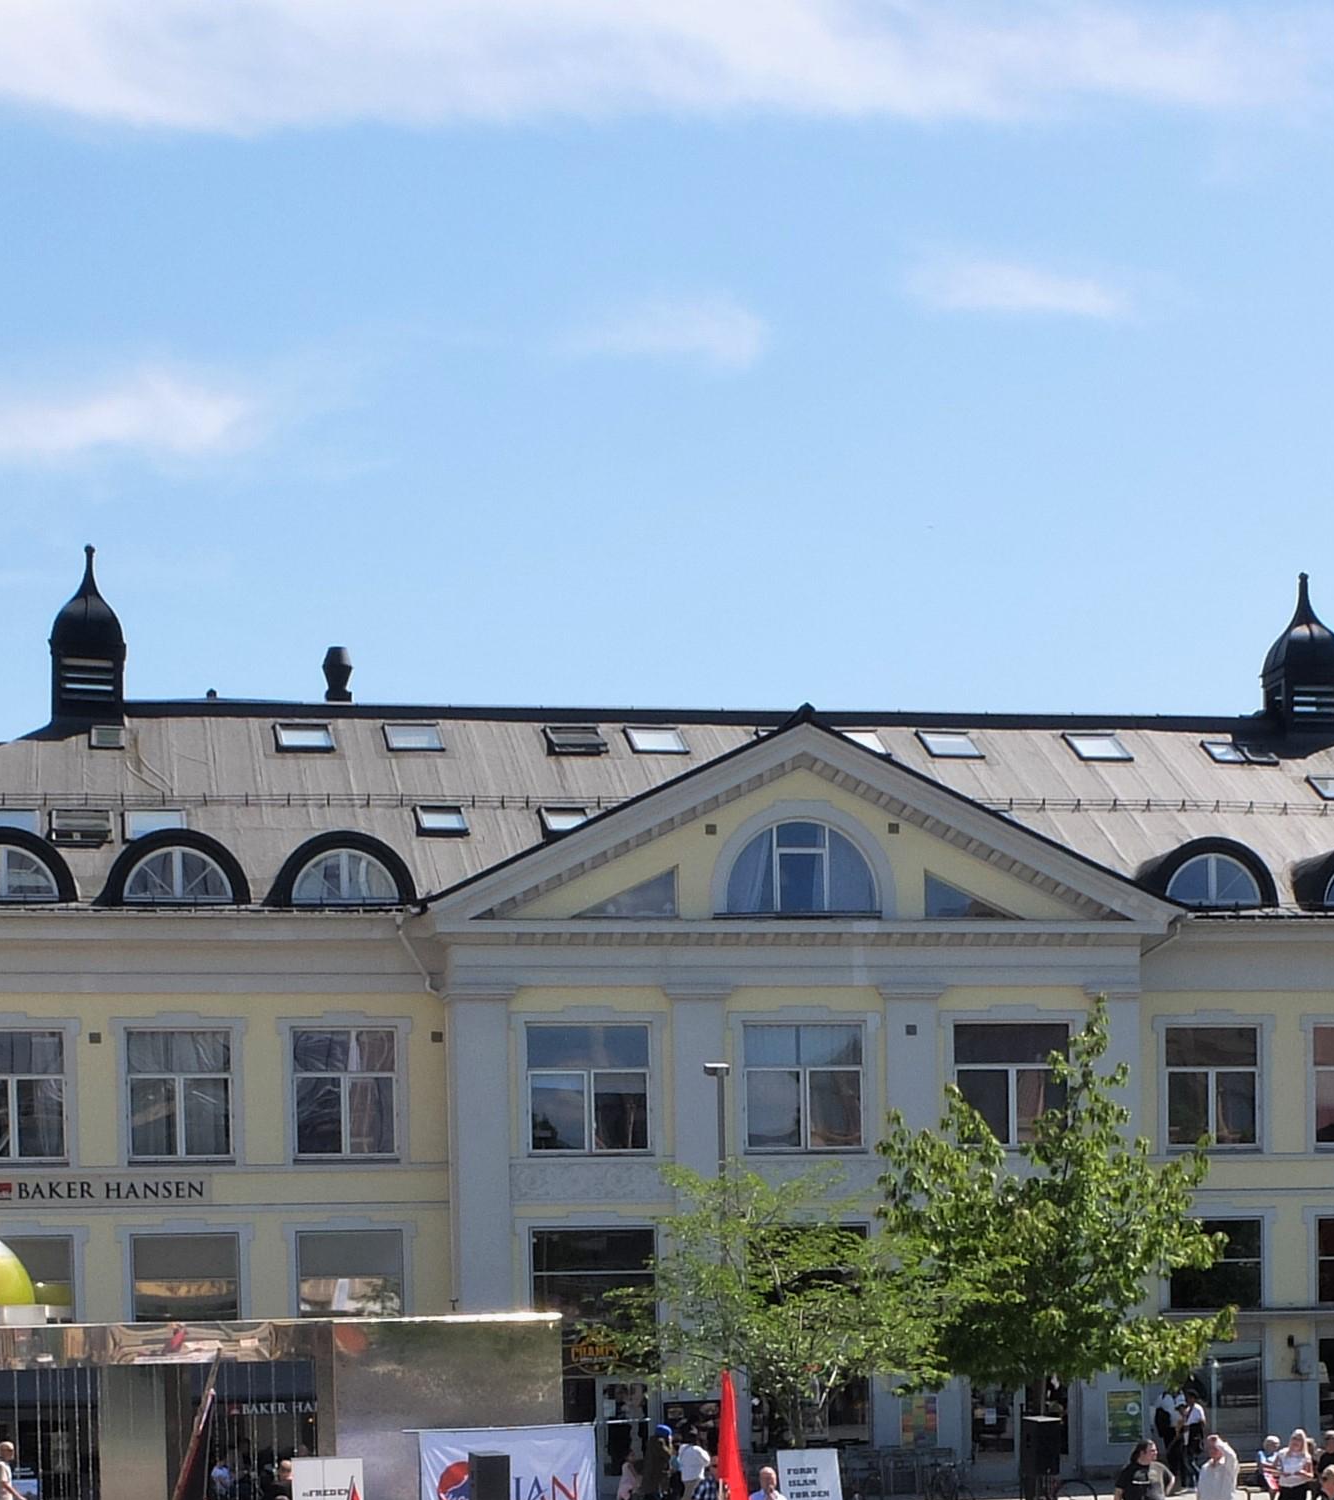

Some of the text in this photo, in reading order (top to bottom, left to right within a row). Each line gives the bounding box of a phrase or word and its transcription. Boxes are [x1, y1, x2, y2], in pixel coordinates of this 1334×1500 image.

[17, 1181, 205, 1200] BAKER HANSEN
[241, 1402, 288, 1415] BAKER
